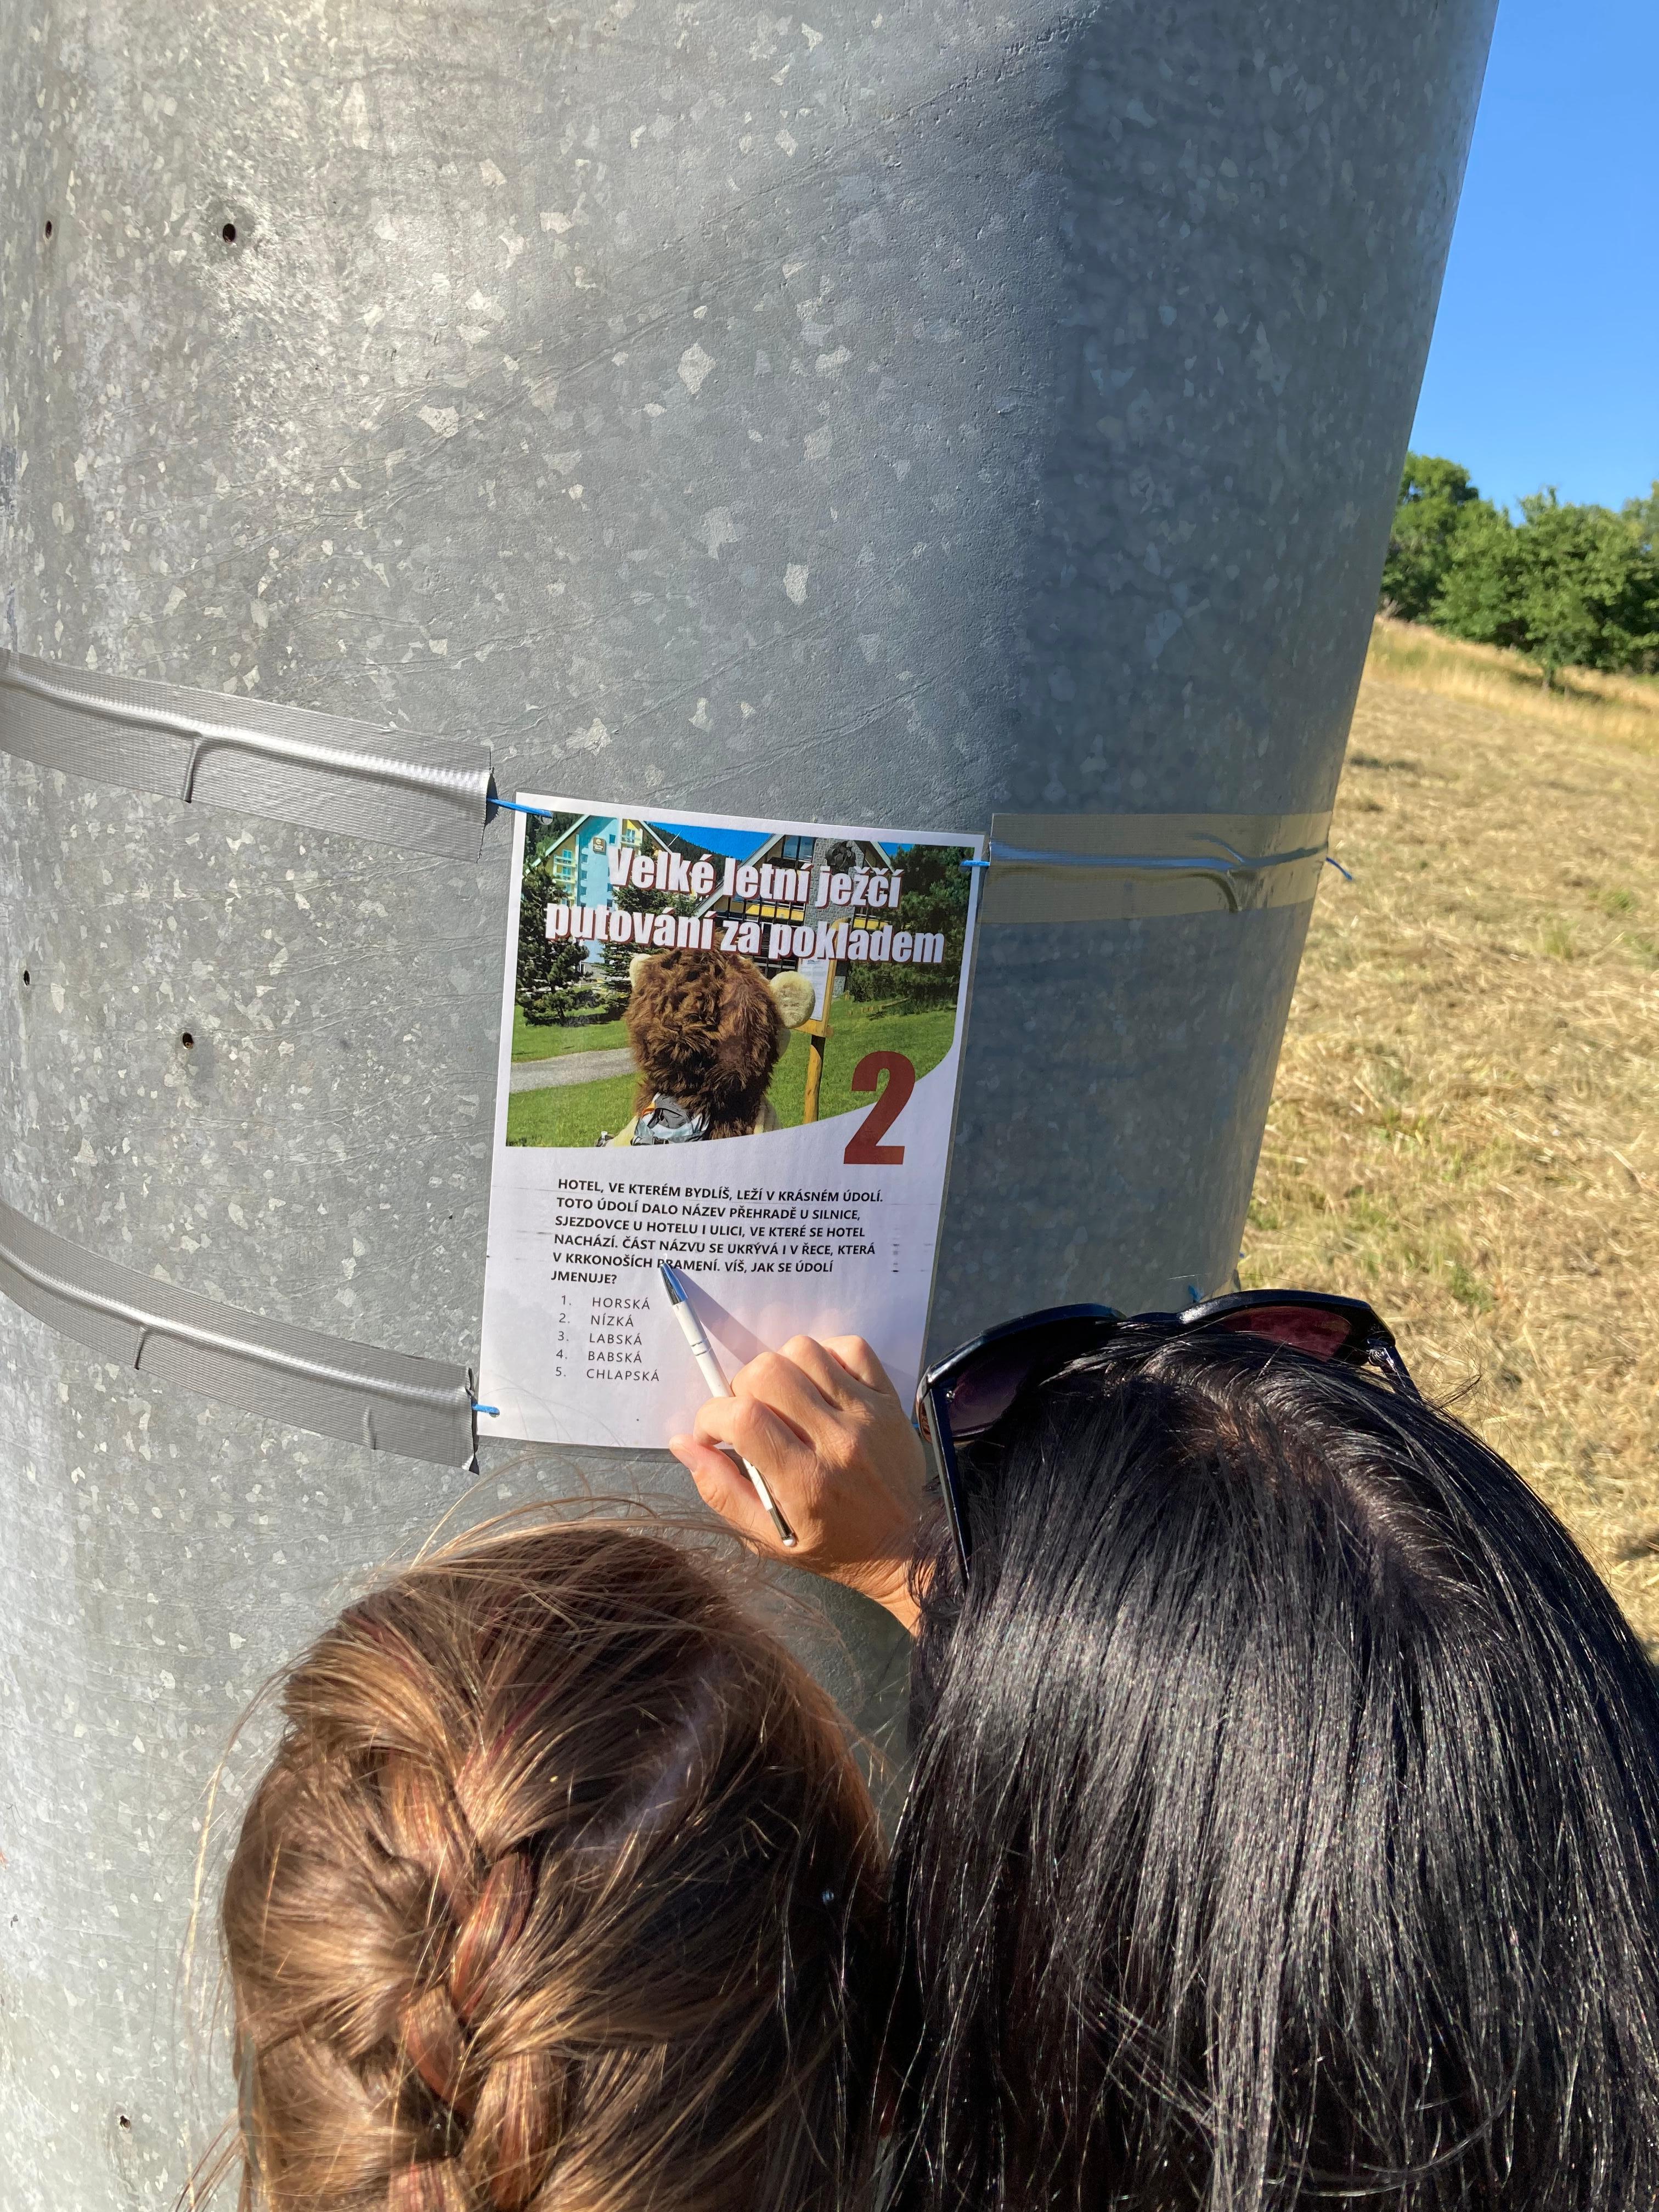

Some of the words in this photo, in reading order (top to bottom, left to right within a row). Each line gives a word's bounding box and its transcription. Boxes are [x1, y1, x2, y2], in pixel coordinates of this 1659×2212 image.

[607, 848, 714, 895] Velké
[723, 857, 810, 904] letní
[815, 867, 904, 909] ježčí
[545, 904, 716, 951] putování
[720, 919, 762, 954] za
[769, 922, 945, 964] pokladem
[843, 1050, 916, 1165] 2
[558, 1178, 604, 1194] HOTEL,
[608, 1182, 625, 1193] VE
[628, 1183, 681, 1197] KTERÉM
[685, 1186, 732, 1201] BYDLÍŠ,
[737, 1187, 764, 1200] LEŽÍ
[766, 1190, 775, 1201] V
[778, 1188, 839, 1202] KRÁSNÉM
[843, 1189, 883, 1203] ÚDOLÍ.
[556, 1197, 593, 1210] TOTO
[597, 1197, 639, 1213] ÚDOLÍ
[642, 1203, 678, 1215] DALO
[681, 1203, 726, 1217] NÁZEV
[729, 1205, 797, 1219] PŘEHRADĚ
[800, 1209, 809, 1220] U
[811, 1209, 861, 1221] SILNICE,
[555, 1215, 630, 1231] SJEZDOVCE
[633, 1221, 643, 1231] U
[646, 1221, 698, 1234] HOTELU
[702, 1224, 706, 1235] I
[710, 1224, 746, 1238] ULICI,
[749, 1226, 765, 1237] VE
[769, 1224, 806, 1237] KTERÉ
[809, 1227, 823, 1237] SE
[826, 1227, 865, 1238] HOTEL
[554, 1233, 618, 1248] NACHÁZÍ.
[622, 1235, 656, 1250] ČÁST
[659, 1238, 706, 1254] NÁZVU
[709, 1243, 724, 1254] SE
[727, 1242, 779, 1255] UKRÝVÁ
[782, 1245, 786, 1255] I
[790, 1245, 799, 1255] V
[802, 1242, 833, 1256] ŘECE,
[838, 1242, 876, 1255] KTERÁ
[552, 1252, 562, 1262] V
[566, 1252, 653, 1268] KRKONOŠÍCH
[724, 1259, 747, 1274] VÍŠ,
[751, 1262, 775, 1273] JAK
[777, 1262, 792, 1273] SE
[795, 1260, 834, 1273] ÚDOLÍ
[550, 1270, 618, 1285] JMENUJE?
[561, 1295, 572, 1306] 1.
[592, 1296, 650, 1310] HORSKÁ
[558, 1312, 570, 1324] 2.
[590, 1312, 634, 1327] NÍZKÁ
[557, 1330, 569, 1341] 3.
[589, 1332, 642, 1346] LABSKÁ
[556, 1348, 567, 1359] 4.
[588, 1350, 642, 1363] BABSKÁ
[555, 1366, 566, 1377] 5.
[586, 1368, 659, 1382] CHLAPSKÁ
